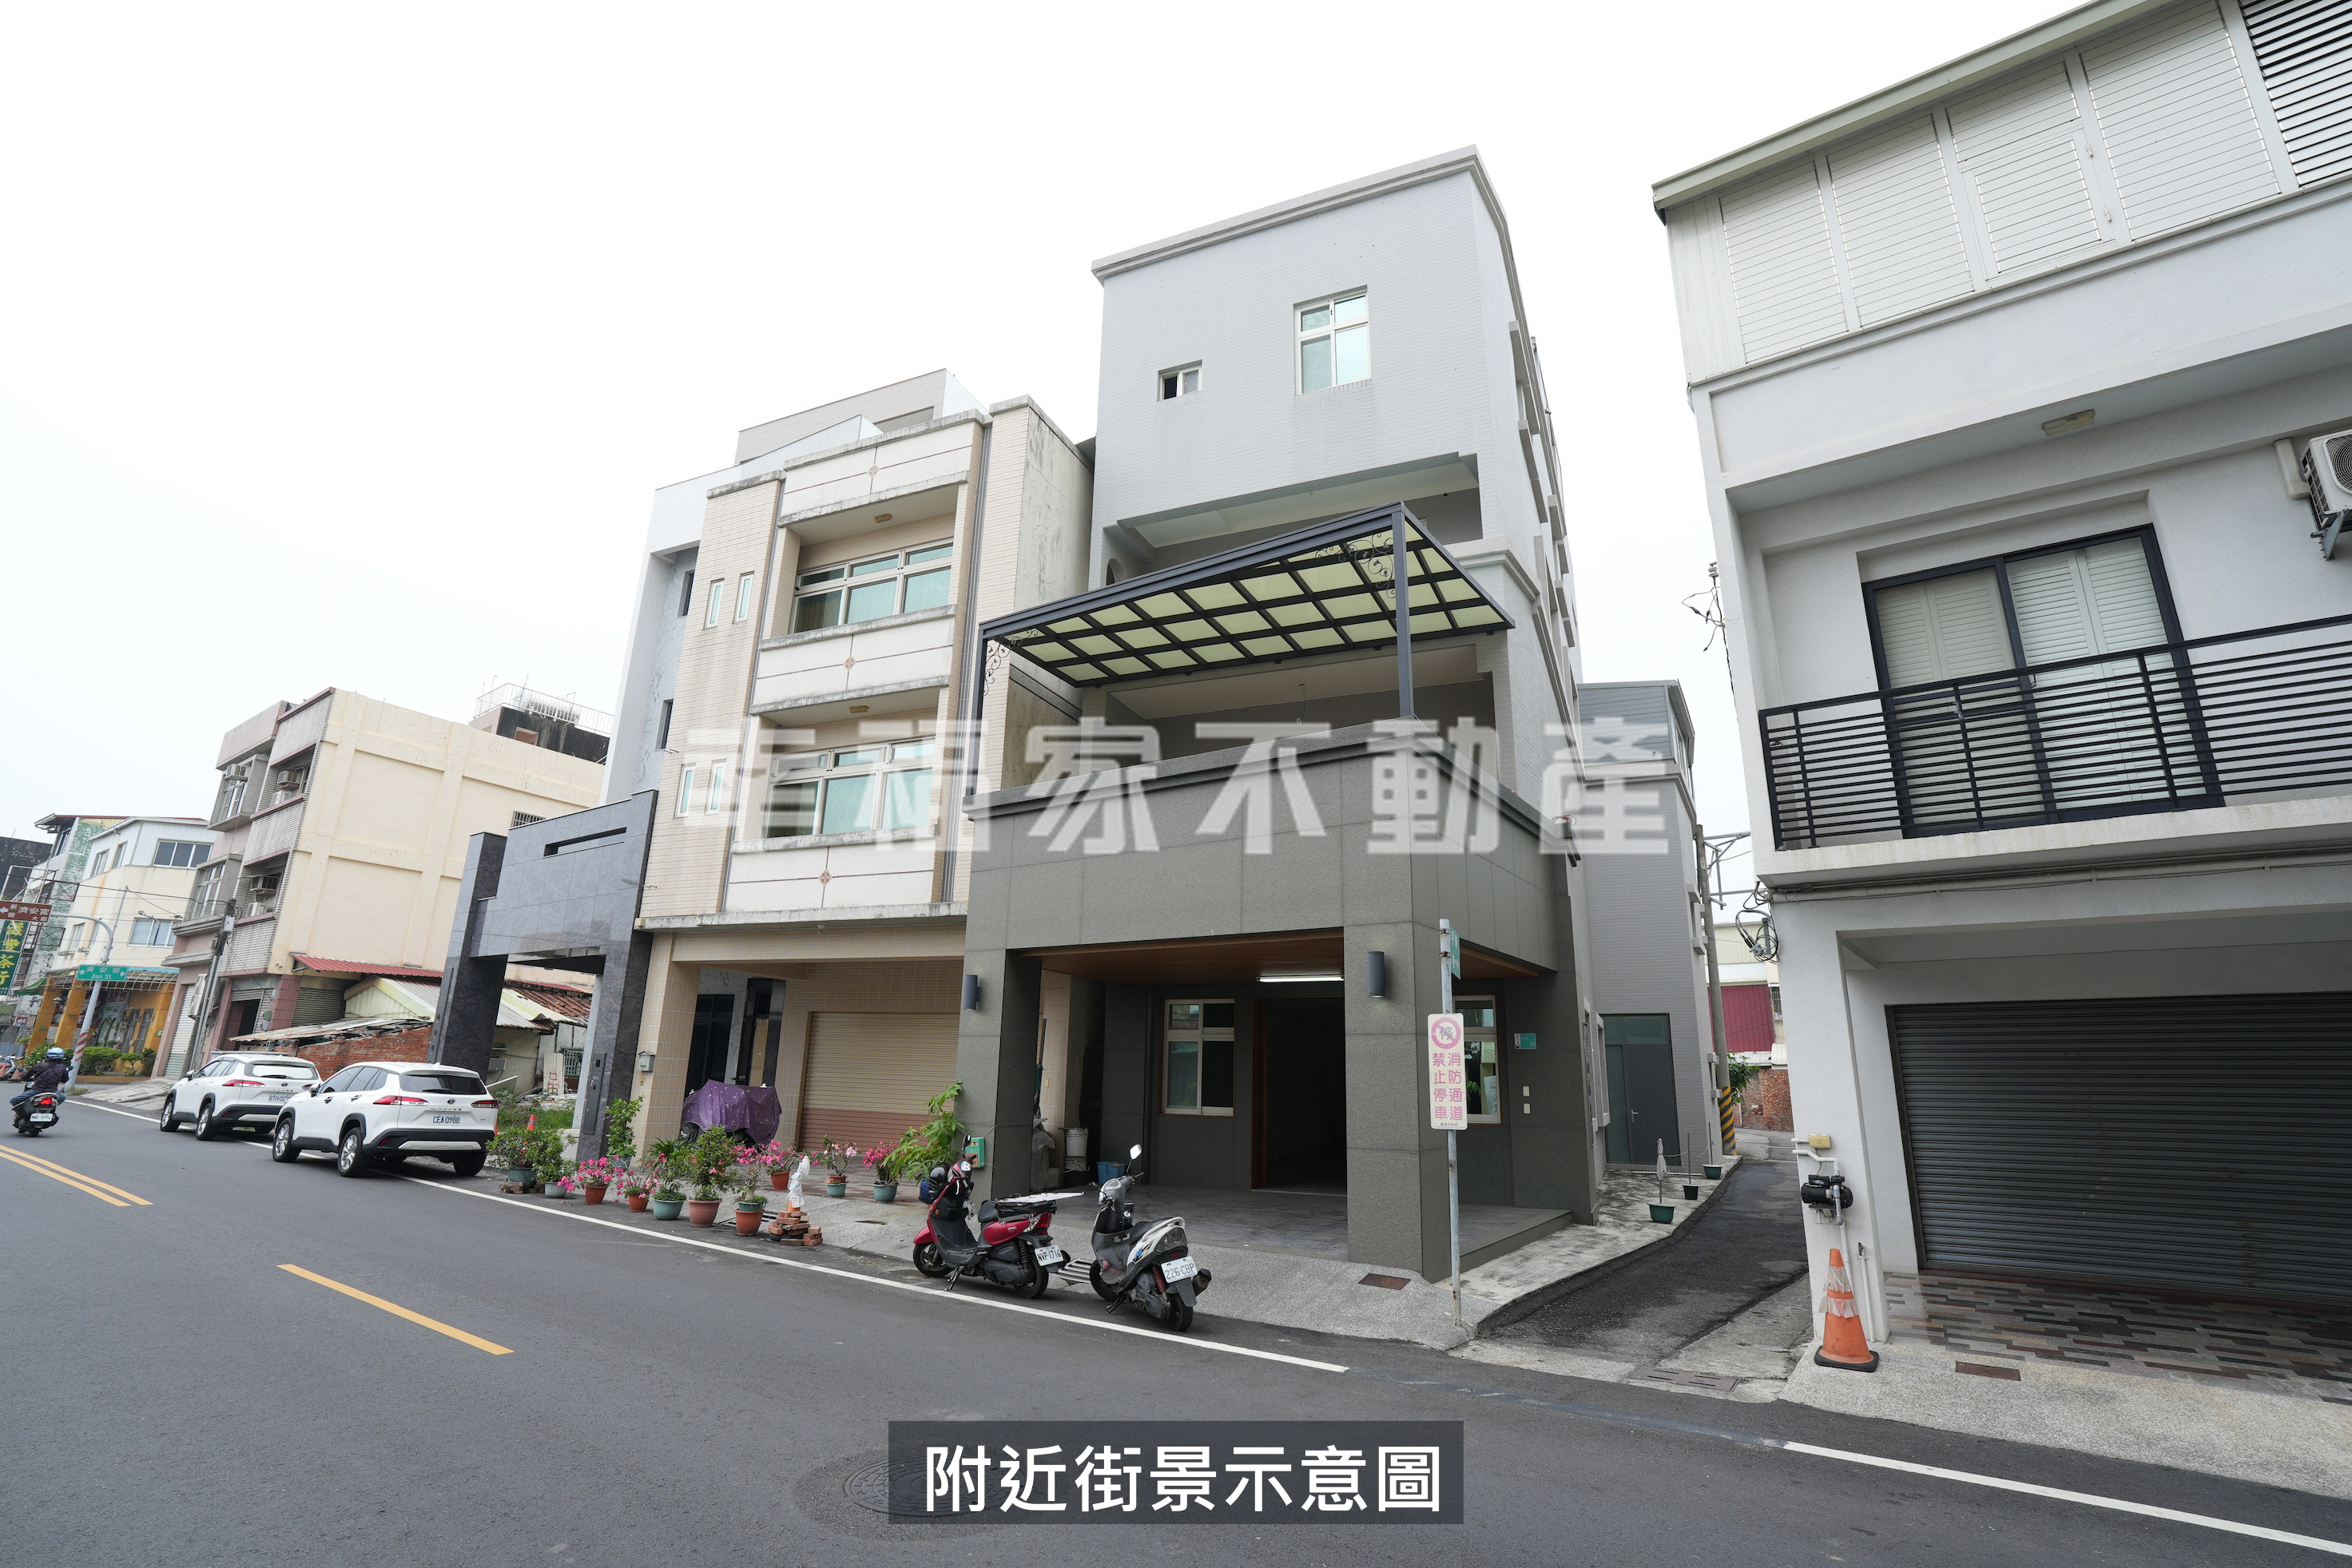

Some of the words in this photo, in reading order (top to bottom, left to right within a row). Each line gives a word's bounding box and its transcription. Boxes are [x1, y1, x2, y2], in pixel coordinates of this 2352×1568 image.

[18, 906, 50, 915] 濟安宮
[1432, 1052, 1448, 1120] 禁止停車
[1448, 1052, 1463, 1120] 消防通道
[1165, 1263, 1194, 1279] 226-CBP
